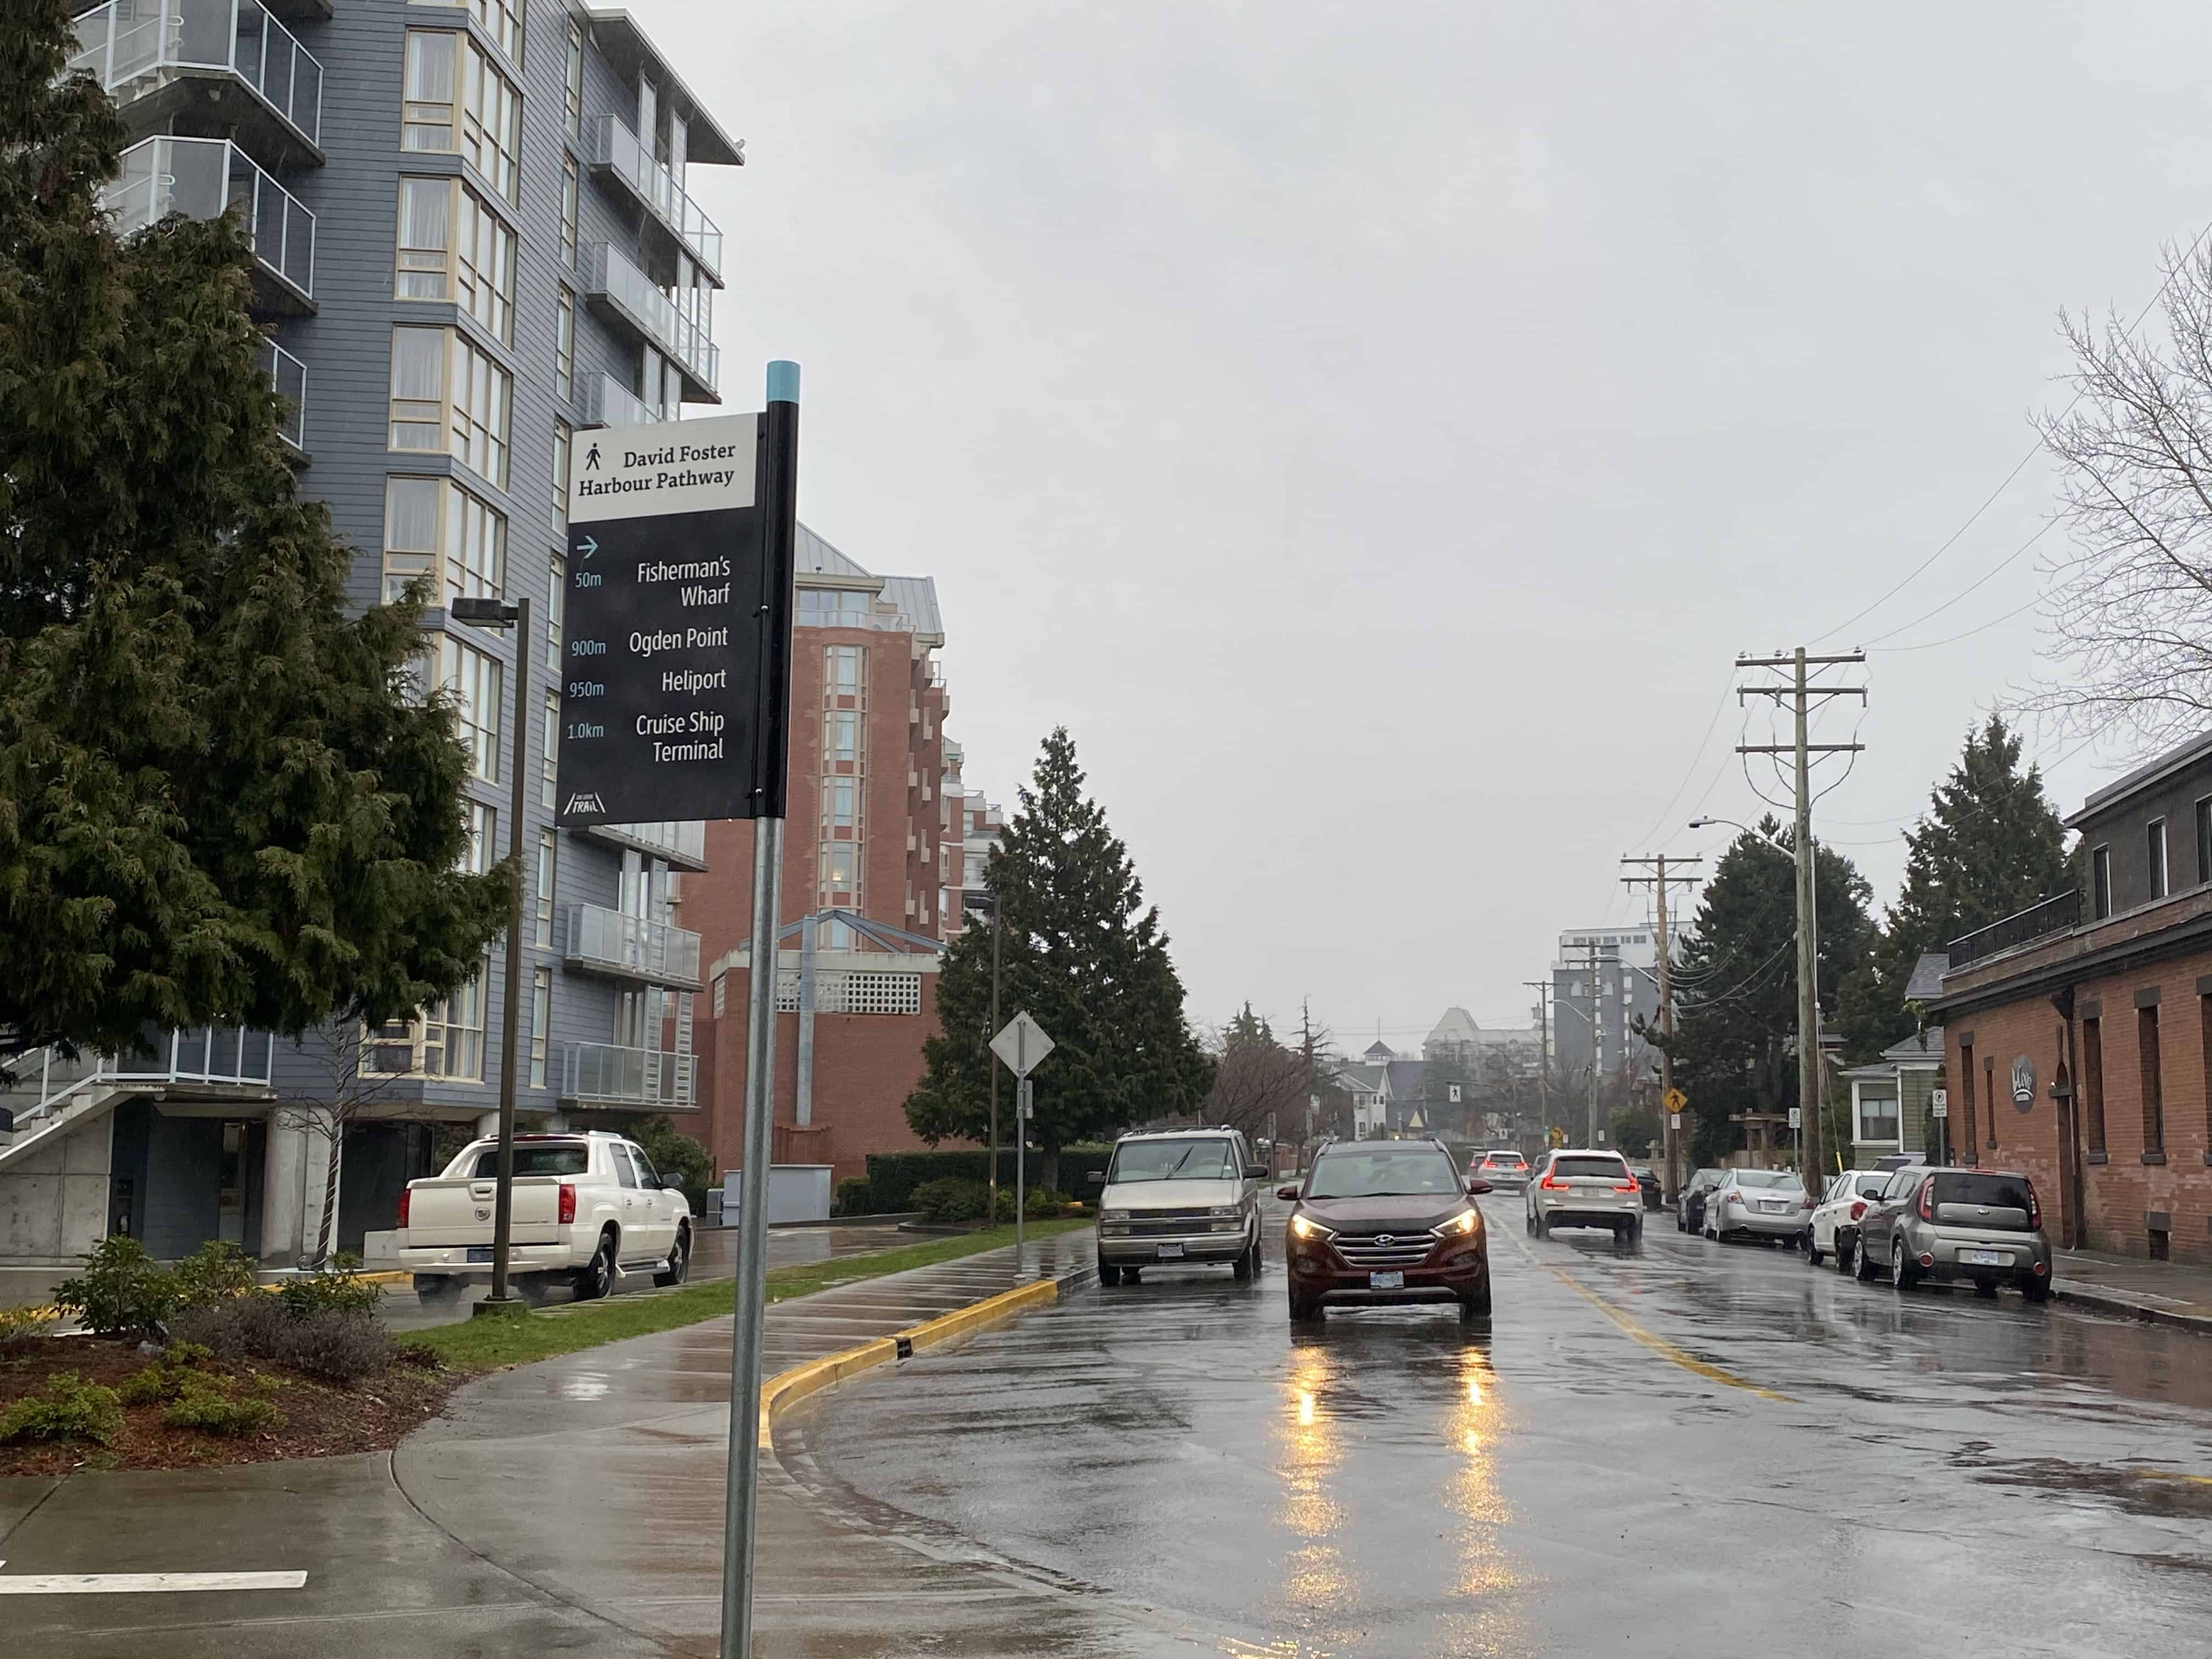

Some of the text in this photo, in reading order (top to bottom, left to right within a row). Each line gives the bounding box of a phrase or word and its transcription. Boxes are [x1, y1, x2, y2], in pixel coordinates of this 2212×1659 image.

[623, 444, 736, 468] David Foster
[578, 470, 735, 496] Harbour Pathway
[574, 572, 601, 588] 50m
[637, 555, 730, 583] Fisherman's
[681, 583, 730, 606] Wharf
[571, 640, 606, 657] 900m
[629, 627, 728, 657] Ogden Point
[569, 681, 604, 698] 950m
[662, 669, 726, 696] Heliport
[568, 723, 604, 739] 1.0km
[636, 710, 724, 737] Cruise Ship
[653, 737, 724, 762] Terminal
